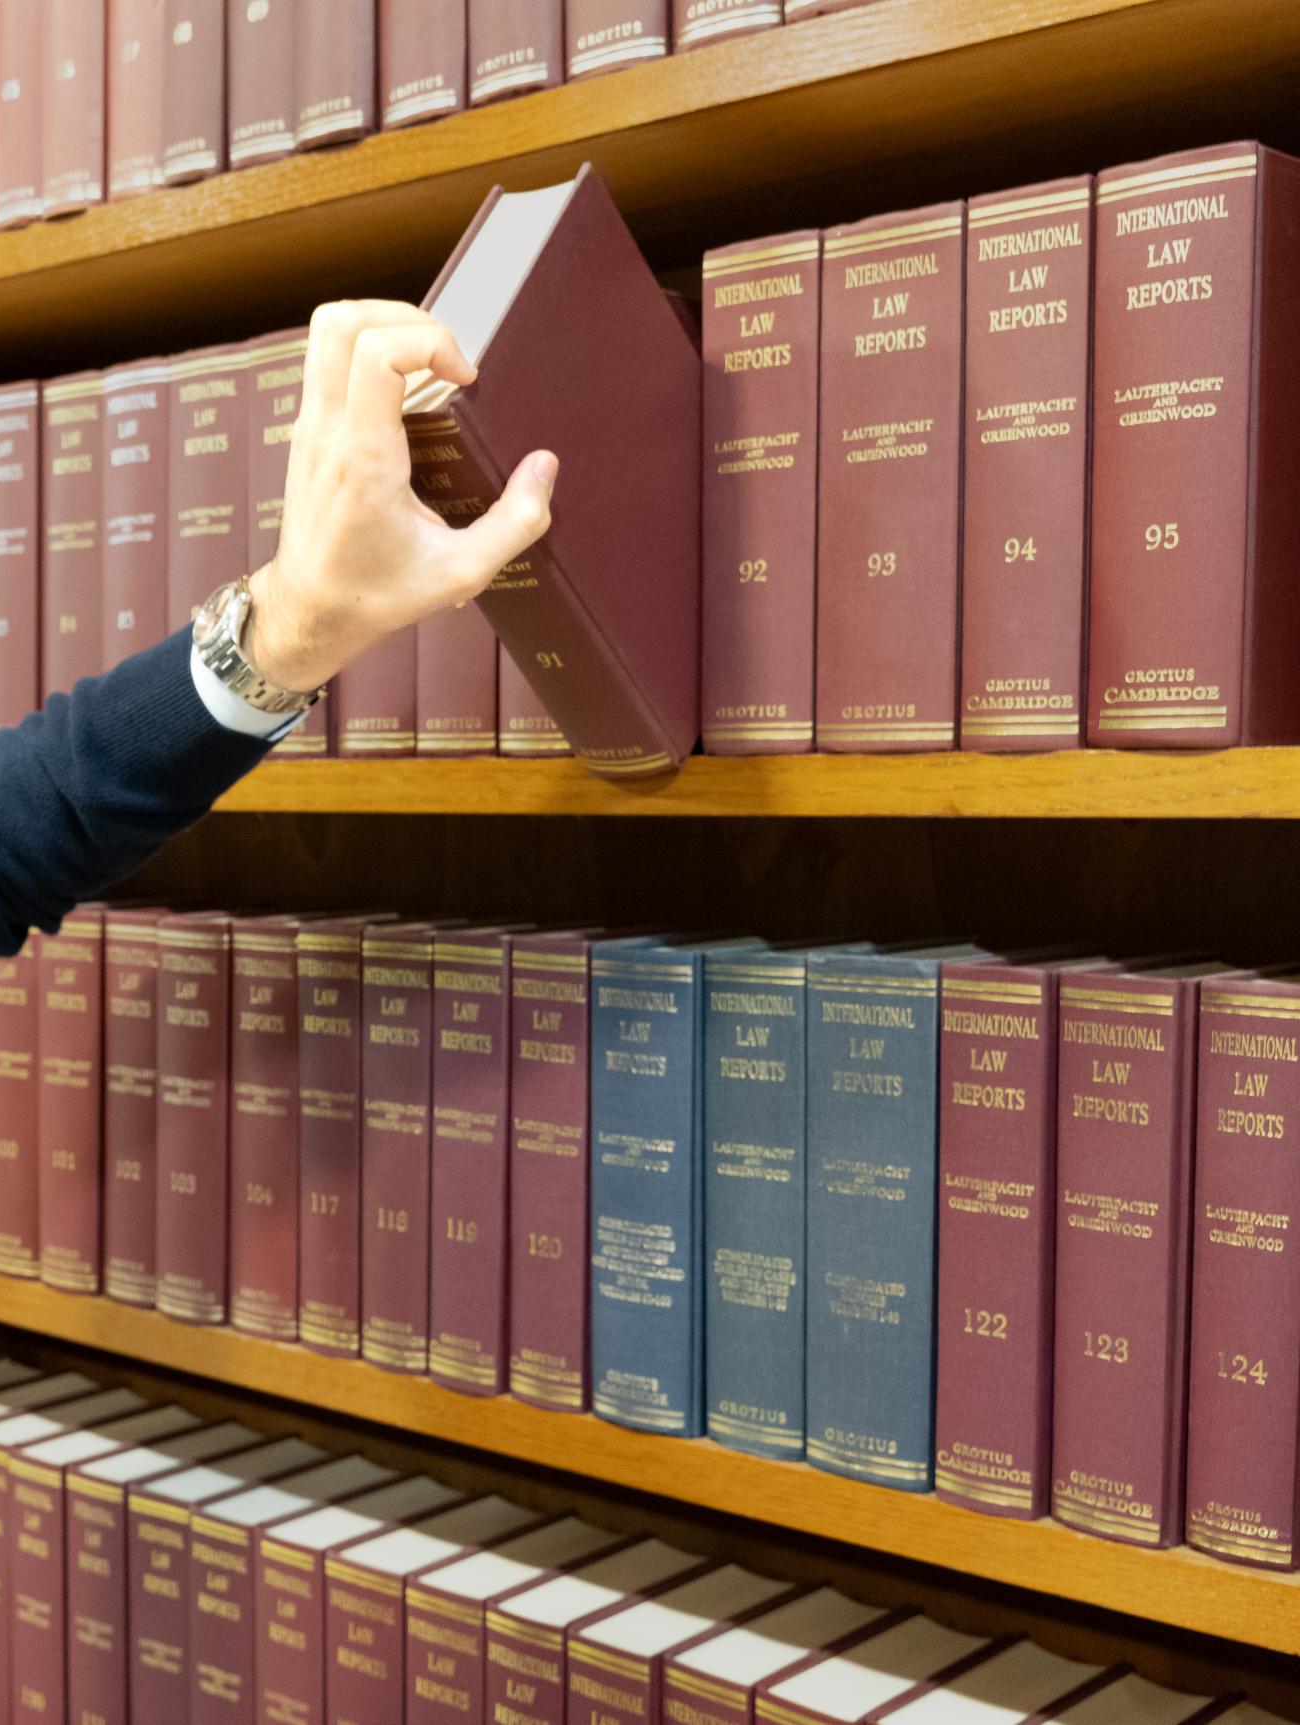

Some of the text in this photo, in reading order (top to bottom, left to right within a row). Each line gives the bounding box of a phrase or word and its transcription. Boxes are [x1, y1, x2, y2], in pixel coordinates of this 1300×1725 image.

[577, 20, 642, 50] GROTIUS
[1116, 195, 1228, 236] INTERNATIONAL
[978, 222, 1082, 262] INTERNATIONAL
[1148, 238, 1191, 268] LAW
[845, 253, 938, 289] INTERNATIONAL
[1009, 265, 1050, 293] LAW
[715, 274, 803, 308] INTERNATIONAL
[1127, 275, 1213, 310] REPORTS
[872, 293, 909, 319] LAW
[989, 300, 1068, 333] REPORTS
[740, 313, 775, 337] LAW
[855, 326, 927, 357] REPORTS
[724, 344, 791, 373] REPORTS
[1115, 378, 1224, 403] LAUTERPACHT
[1154, 396, 1178, 407] AND
[976, 398, 1077, 422] LAUTERPACHT
[1119, 403, 1217, 427] GREENWOOD
[842, 419, 934, 442] LAUTERPACHT
[981, 422, 1070, 445] GREENWOOD
[847, 443, 928, 464] GREENWOOD
[1145, 523, 1180, 550] 95
[1004, 537, 1037, 563] 94
[739, 560, 768, 583] 92
[867, 553, 896, 576] 93
[536, 652, 564, 668] 91
[986, 678, 1051, 692] GROTIUS
[1125, 668, 1195, 683] GROTIUS
[967, 694, 1074, 711] CAMBRIDGE
[1104, 686, 1220, 704] CAMBRIDGE
[716, 704, 787, 718] GROTIUS
[842, 704, 915, 720] GROTIUS
[313, 988, 339, 1006] LAW
[380, 997, 406, 1016] LAW
[710, 992, 796, 1017] INTERNATIONAL
[452, 1002, 480, 1023] LAW
[532, 1010, 562, 1032] LAW
[822, 1001, 915, 1029] INTERNATIONAL
[943, 1009, 1039, 1040] INTERNATIONAL
[303, 1015, 351, 1036] REPORTS
[369, 1025, 420, 1048] REPORTS
[619, 1020, 651, 1043] LAW
[735, 1025, 770, 1047] LAW
[1063, 1020, 1165, 1052] INTERNATIONAL
[440, 1029, 493, 1054] REPORTS
[849, 1036, 885, 1061] LAW
[1210, 1030, 1298, 1061] INTERNATIONAL
[720, 1056, 786, 1082] REPORTS
[970, 1048, 1008, 1073] LAW
[1091, 1060, 1131, 1085] LAW
[952, 1081, 1026, 1111] REPORTS
[1233, 1071, 1269, 1097] LAW
[1072, 1094, 1150, 1126] REPORTS
[1216, 1108, 1285, 1139] REPORTS
[945, 1173, 1035, 1198] LAUTERPACHT
[310, 1192, 340, 1215] 117
[1064, 1189, 1159, 1217] LAUTERPACHT
[377, 1207, 409, 1232] 118
[1067, 1214, 1153, 1239] GREENWOOD
[1206, 1204, 1290, 1229] LAUTERPACHT
[446, 1216, 478, 1243] 119
[1208, 1228, 1284, 1252] GREENWOOD
[528, 1232, 562, 1260] 120
[963, 1307, 1009, 1340] 122
[1083, 1331, 1130, 1363] 123
[1217, 1351, 1268, 1386] 124
[719, 1400, 788, 1425] GROTIUS
[952, 1441, 1014, 1466] GROTIUS
[1070, 1469, 1134, 1497] GROTIUS
[1054, 1480, 1154, 1519] CAMBRIDGE
[506, 1679, 537, 1705] LAW
